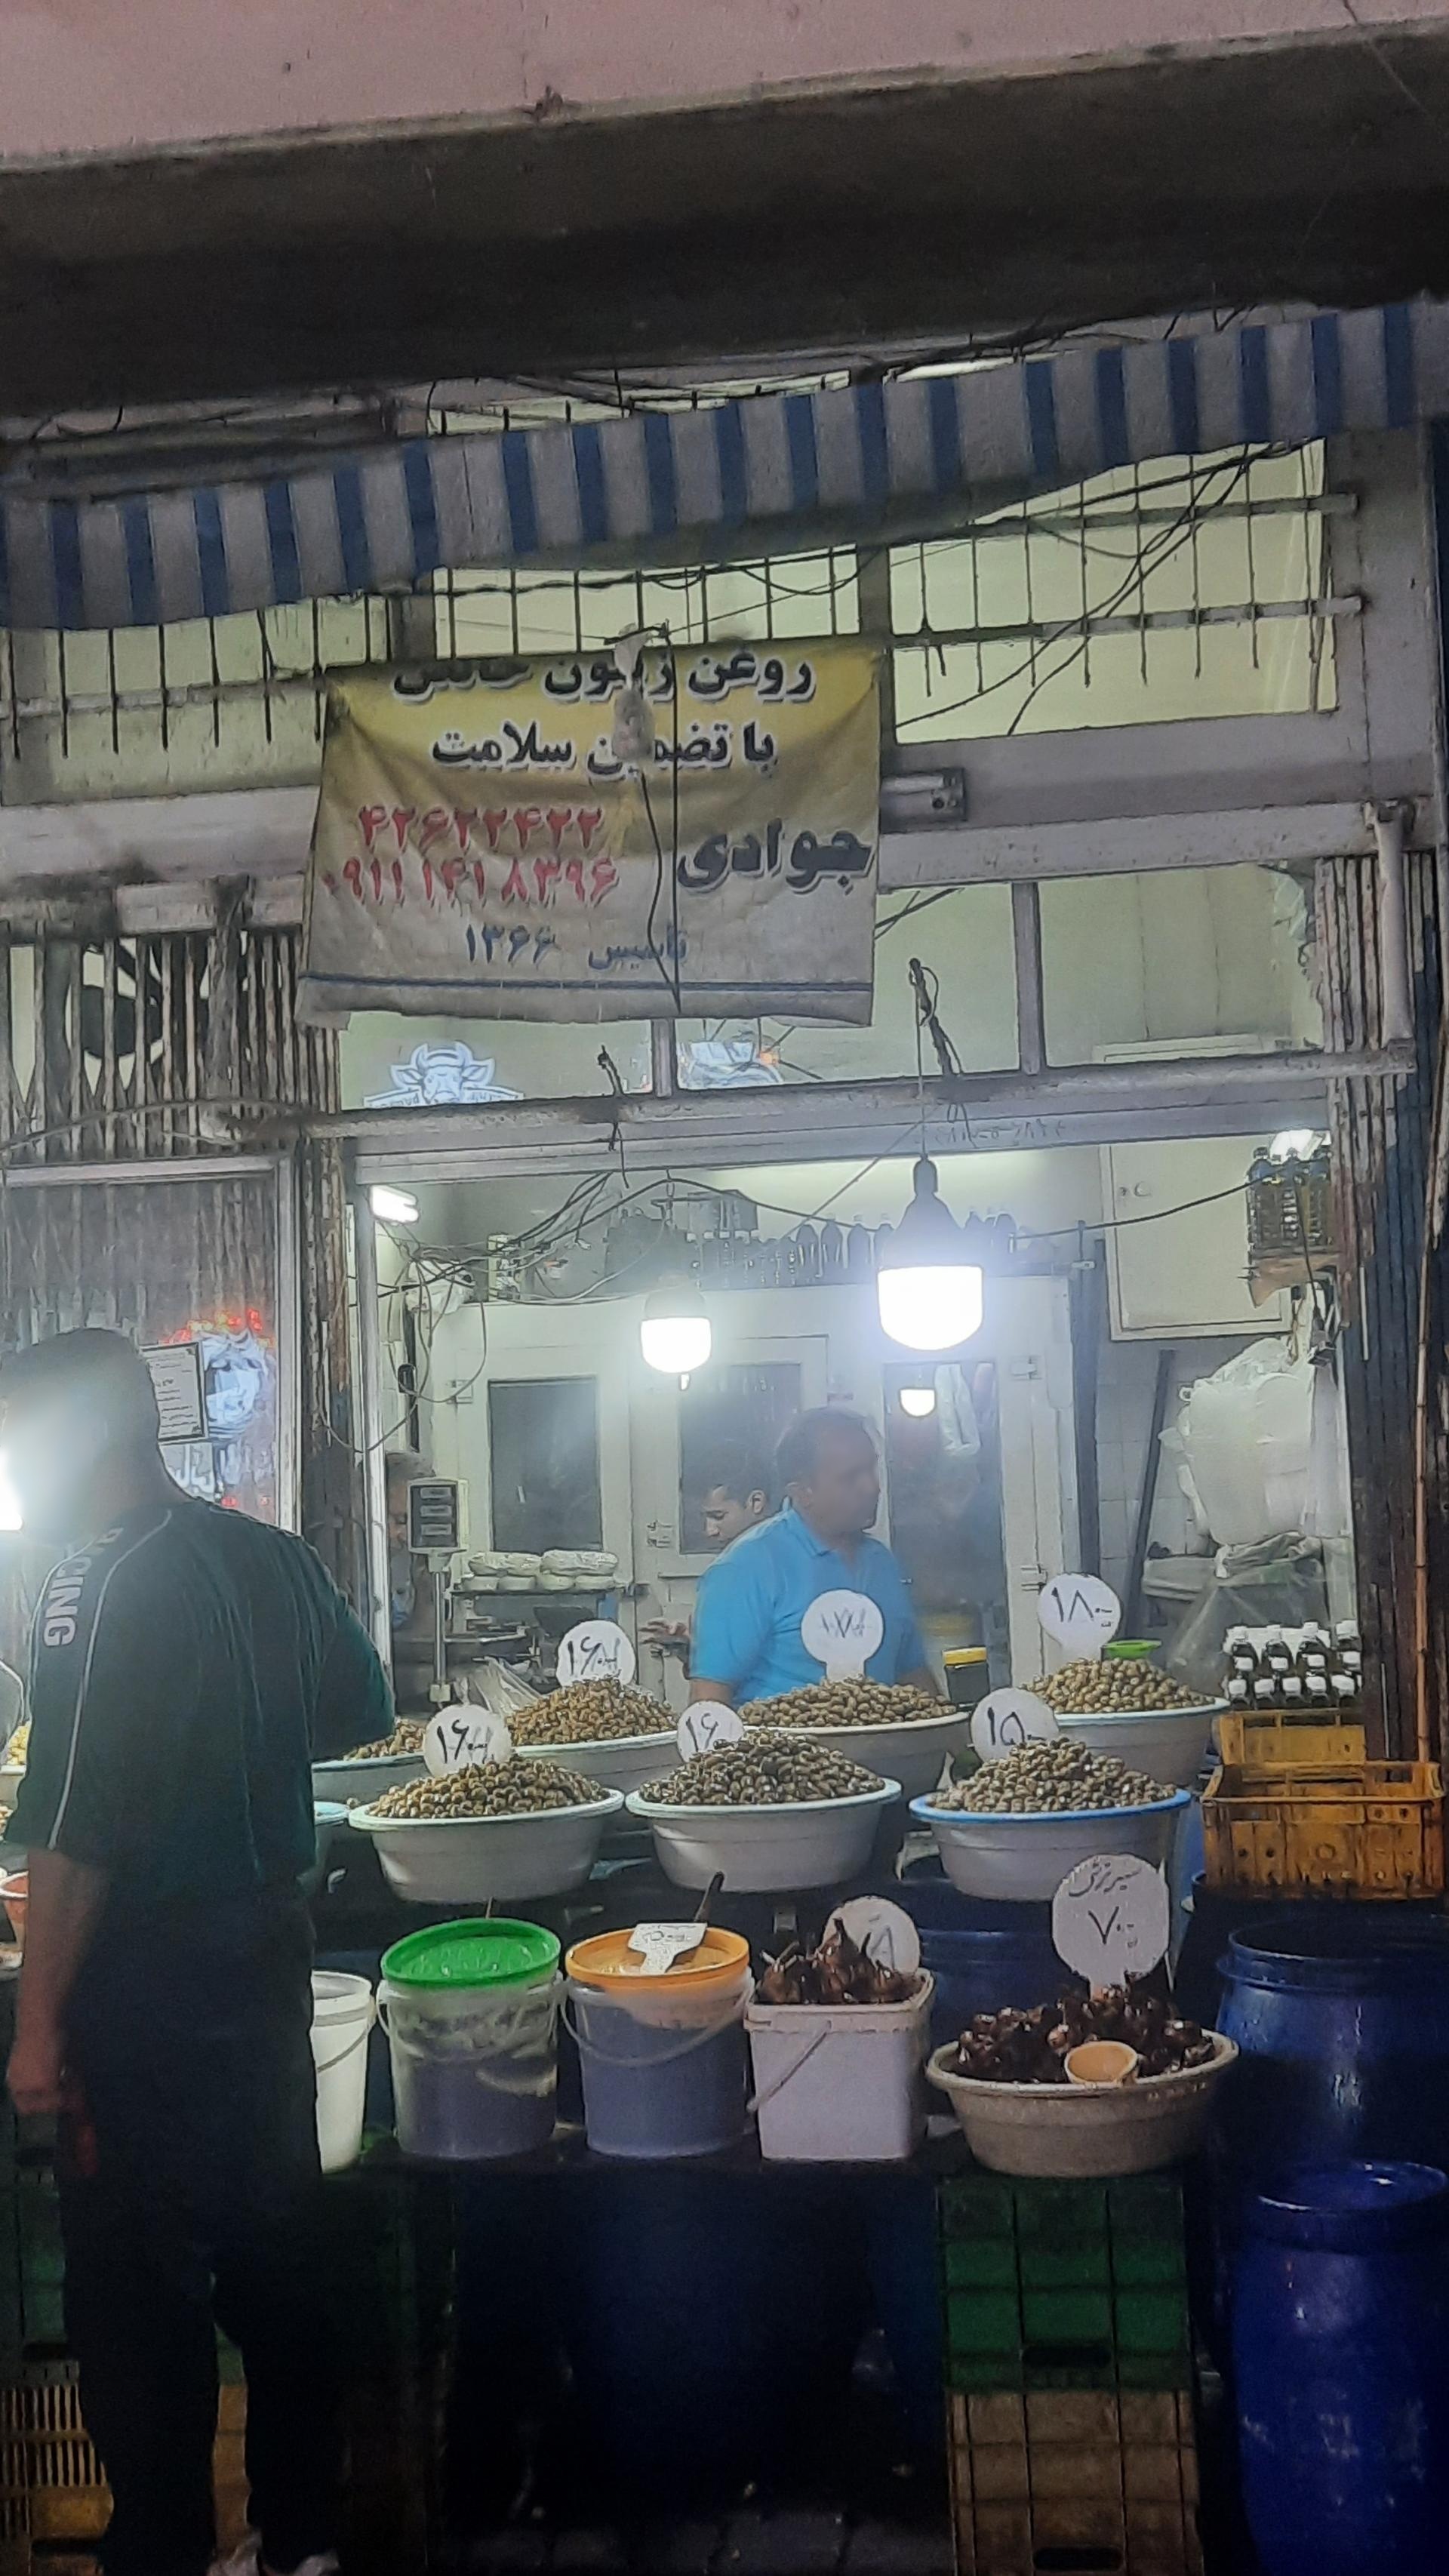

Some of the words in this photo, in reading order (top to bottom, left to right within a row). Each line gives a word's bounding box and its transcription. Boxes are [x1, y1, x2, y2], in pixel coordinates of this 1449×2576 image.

[543, 654, 677, 703] زون
[688, 648, 817, 701] روغن
[430, 719, 577, 772] سلامت
[586, 722, 735, 780] تضمن
[743, 722, 780, 777] با
[678, 817, 876, 894] جوادی
